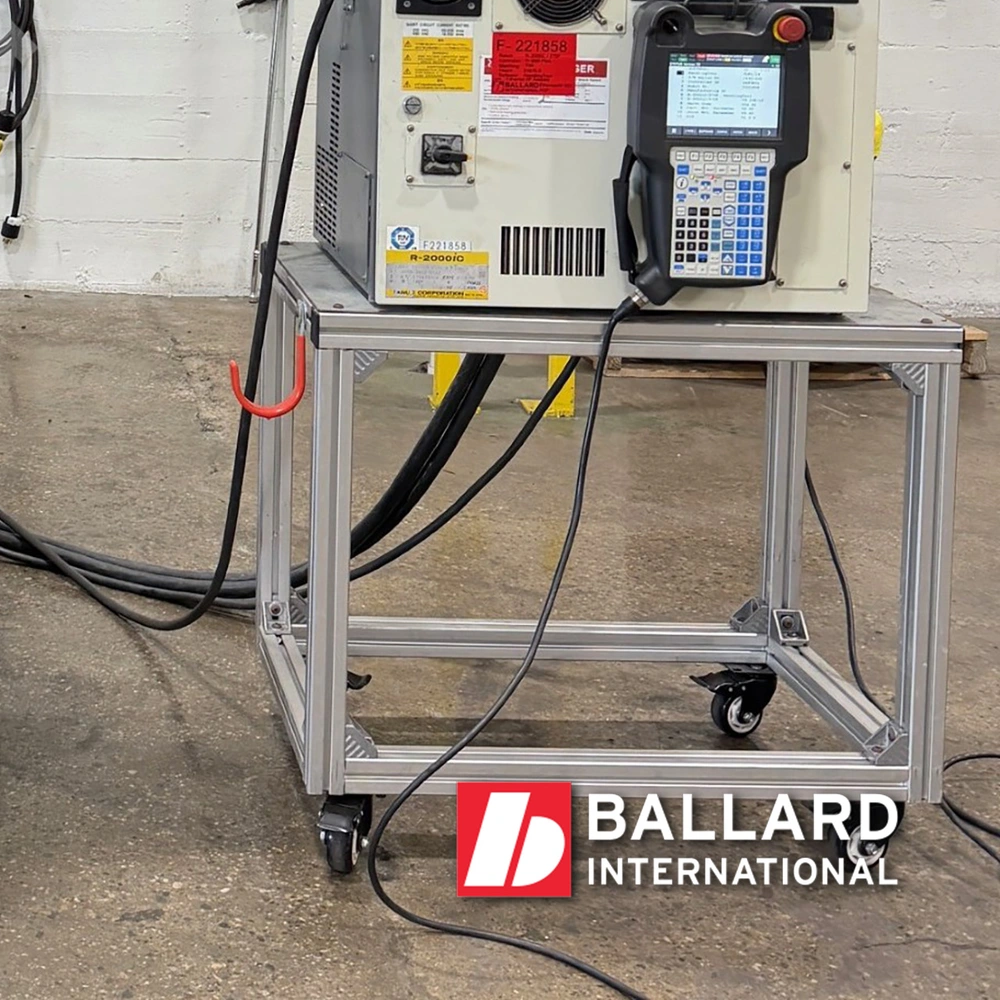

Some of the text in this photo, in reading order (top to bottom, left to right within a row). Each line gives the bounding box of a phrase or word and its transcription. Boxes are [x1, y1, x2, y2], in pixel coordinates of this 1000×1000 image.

[515, 40, 567, 52] 221858
[423, 240, 467, 250] F221858
[410, 252, 464, 262] R-2000iC
